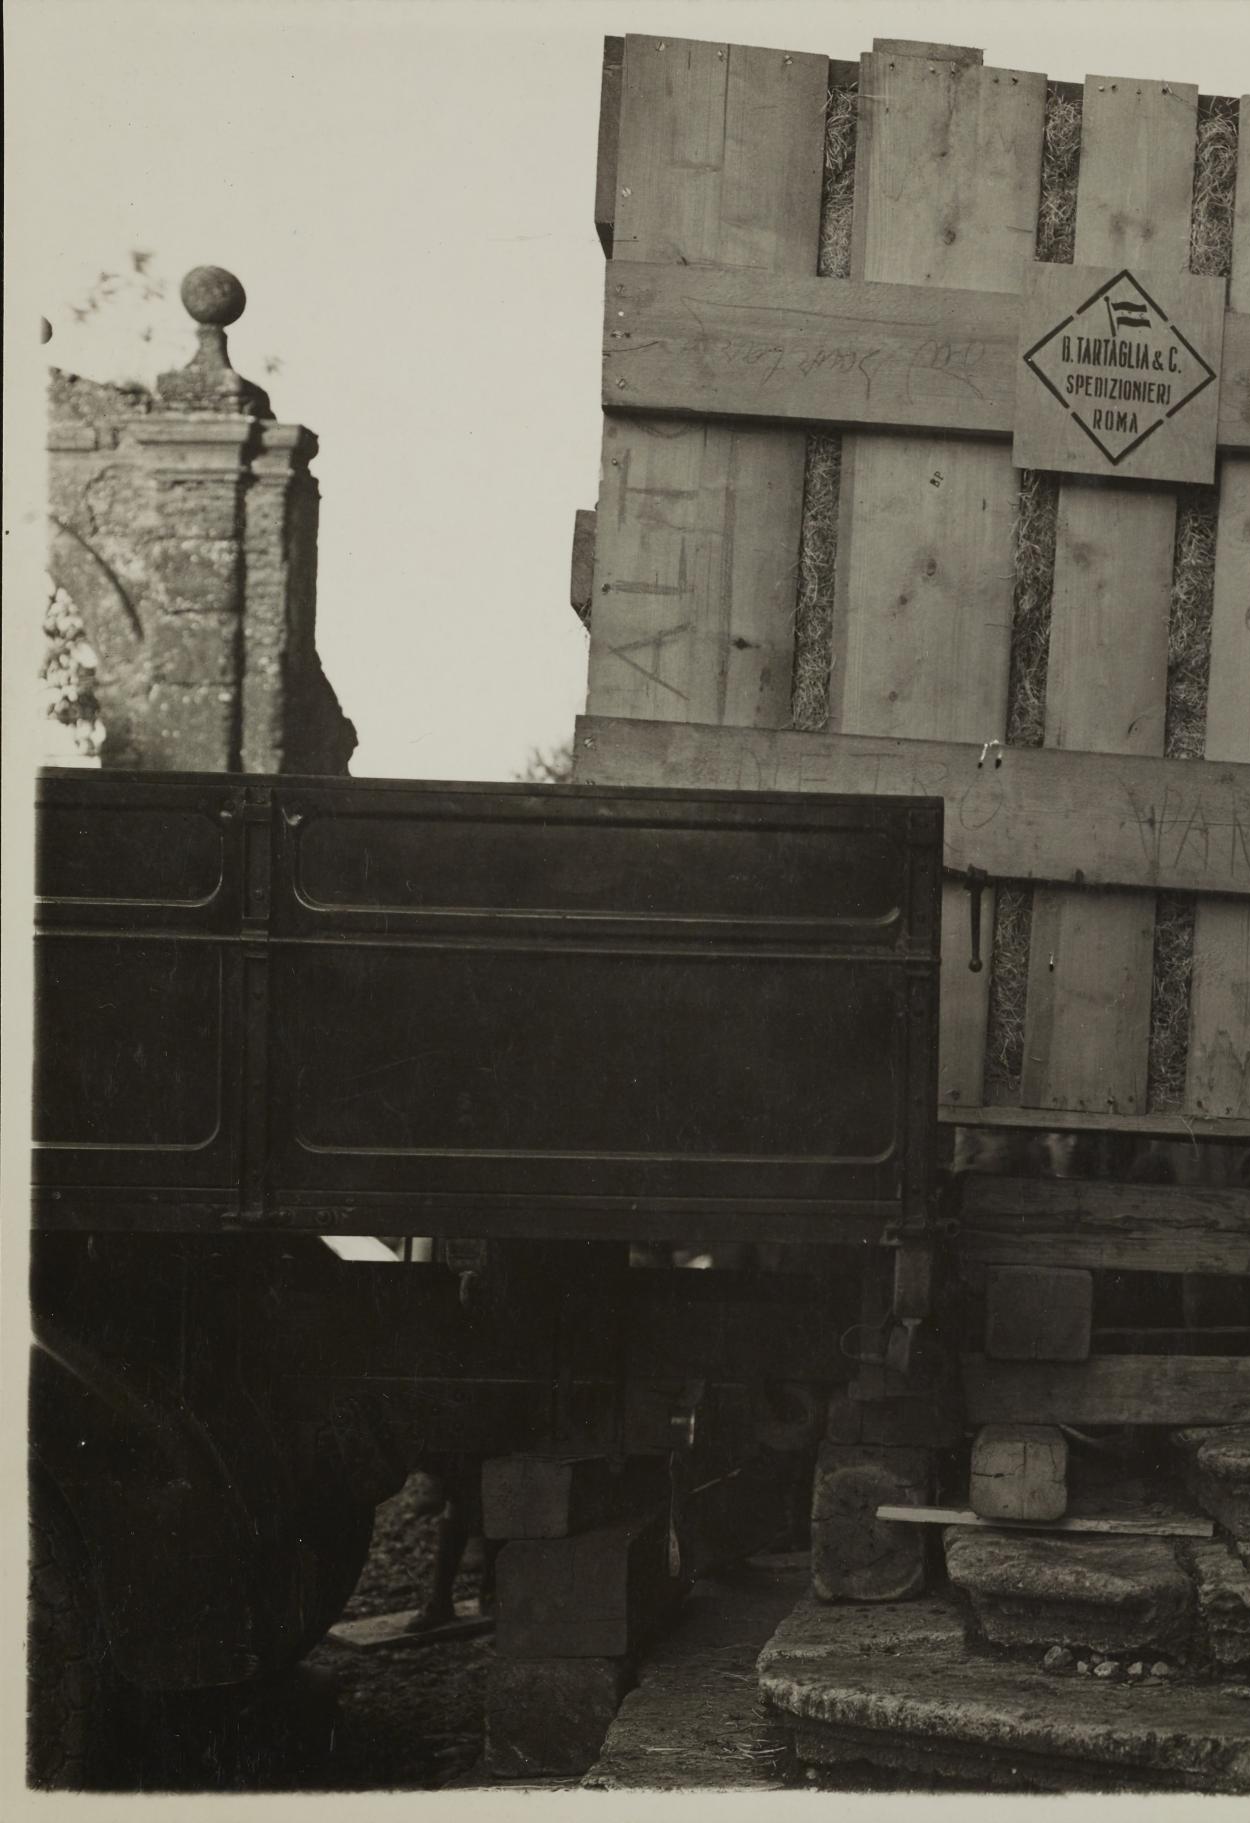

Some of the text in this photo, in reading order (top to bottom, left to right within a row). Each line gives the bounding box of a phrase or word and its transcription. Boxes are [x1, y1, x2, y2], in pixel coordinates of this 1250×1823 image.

[1077, 336, 1150, 371] TARTAGLIA
[1152, 350, 1165, 372] &
[1168, 346, 1183, 375] C.
[1066, 374, 1172, 406] SPEDIZIONIERI
[1093, 408, 1139, 434] ROMA
